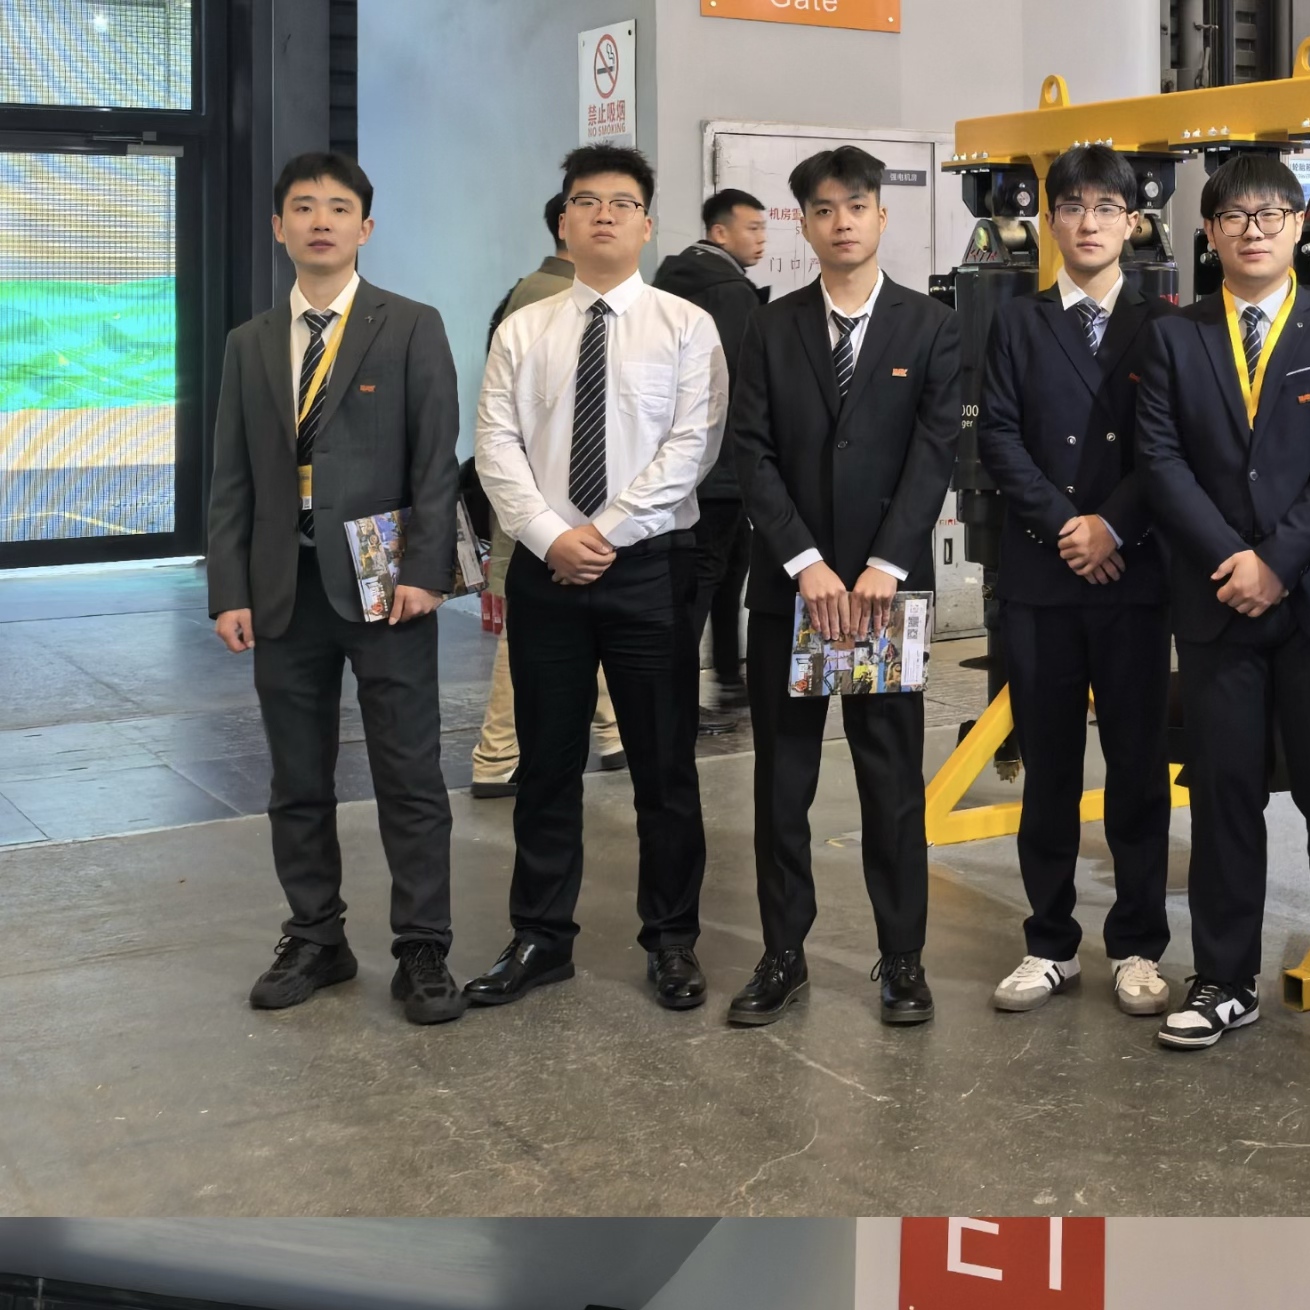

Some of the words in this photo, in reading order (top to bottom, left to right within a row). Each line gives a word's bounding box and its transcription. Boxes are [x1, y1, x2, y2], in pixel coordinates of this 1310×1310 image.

[770, 0, 838, 12] ae
[588, 100, 626, 126] 禁止吸烟
[588, 127, 597, 137] NO
[598, 122, 626, 136] SMOKING
[889, 173, 918, 182] 强电机房
[961, 419, 973, 428] ger
